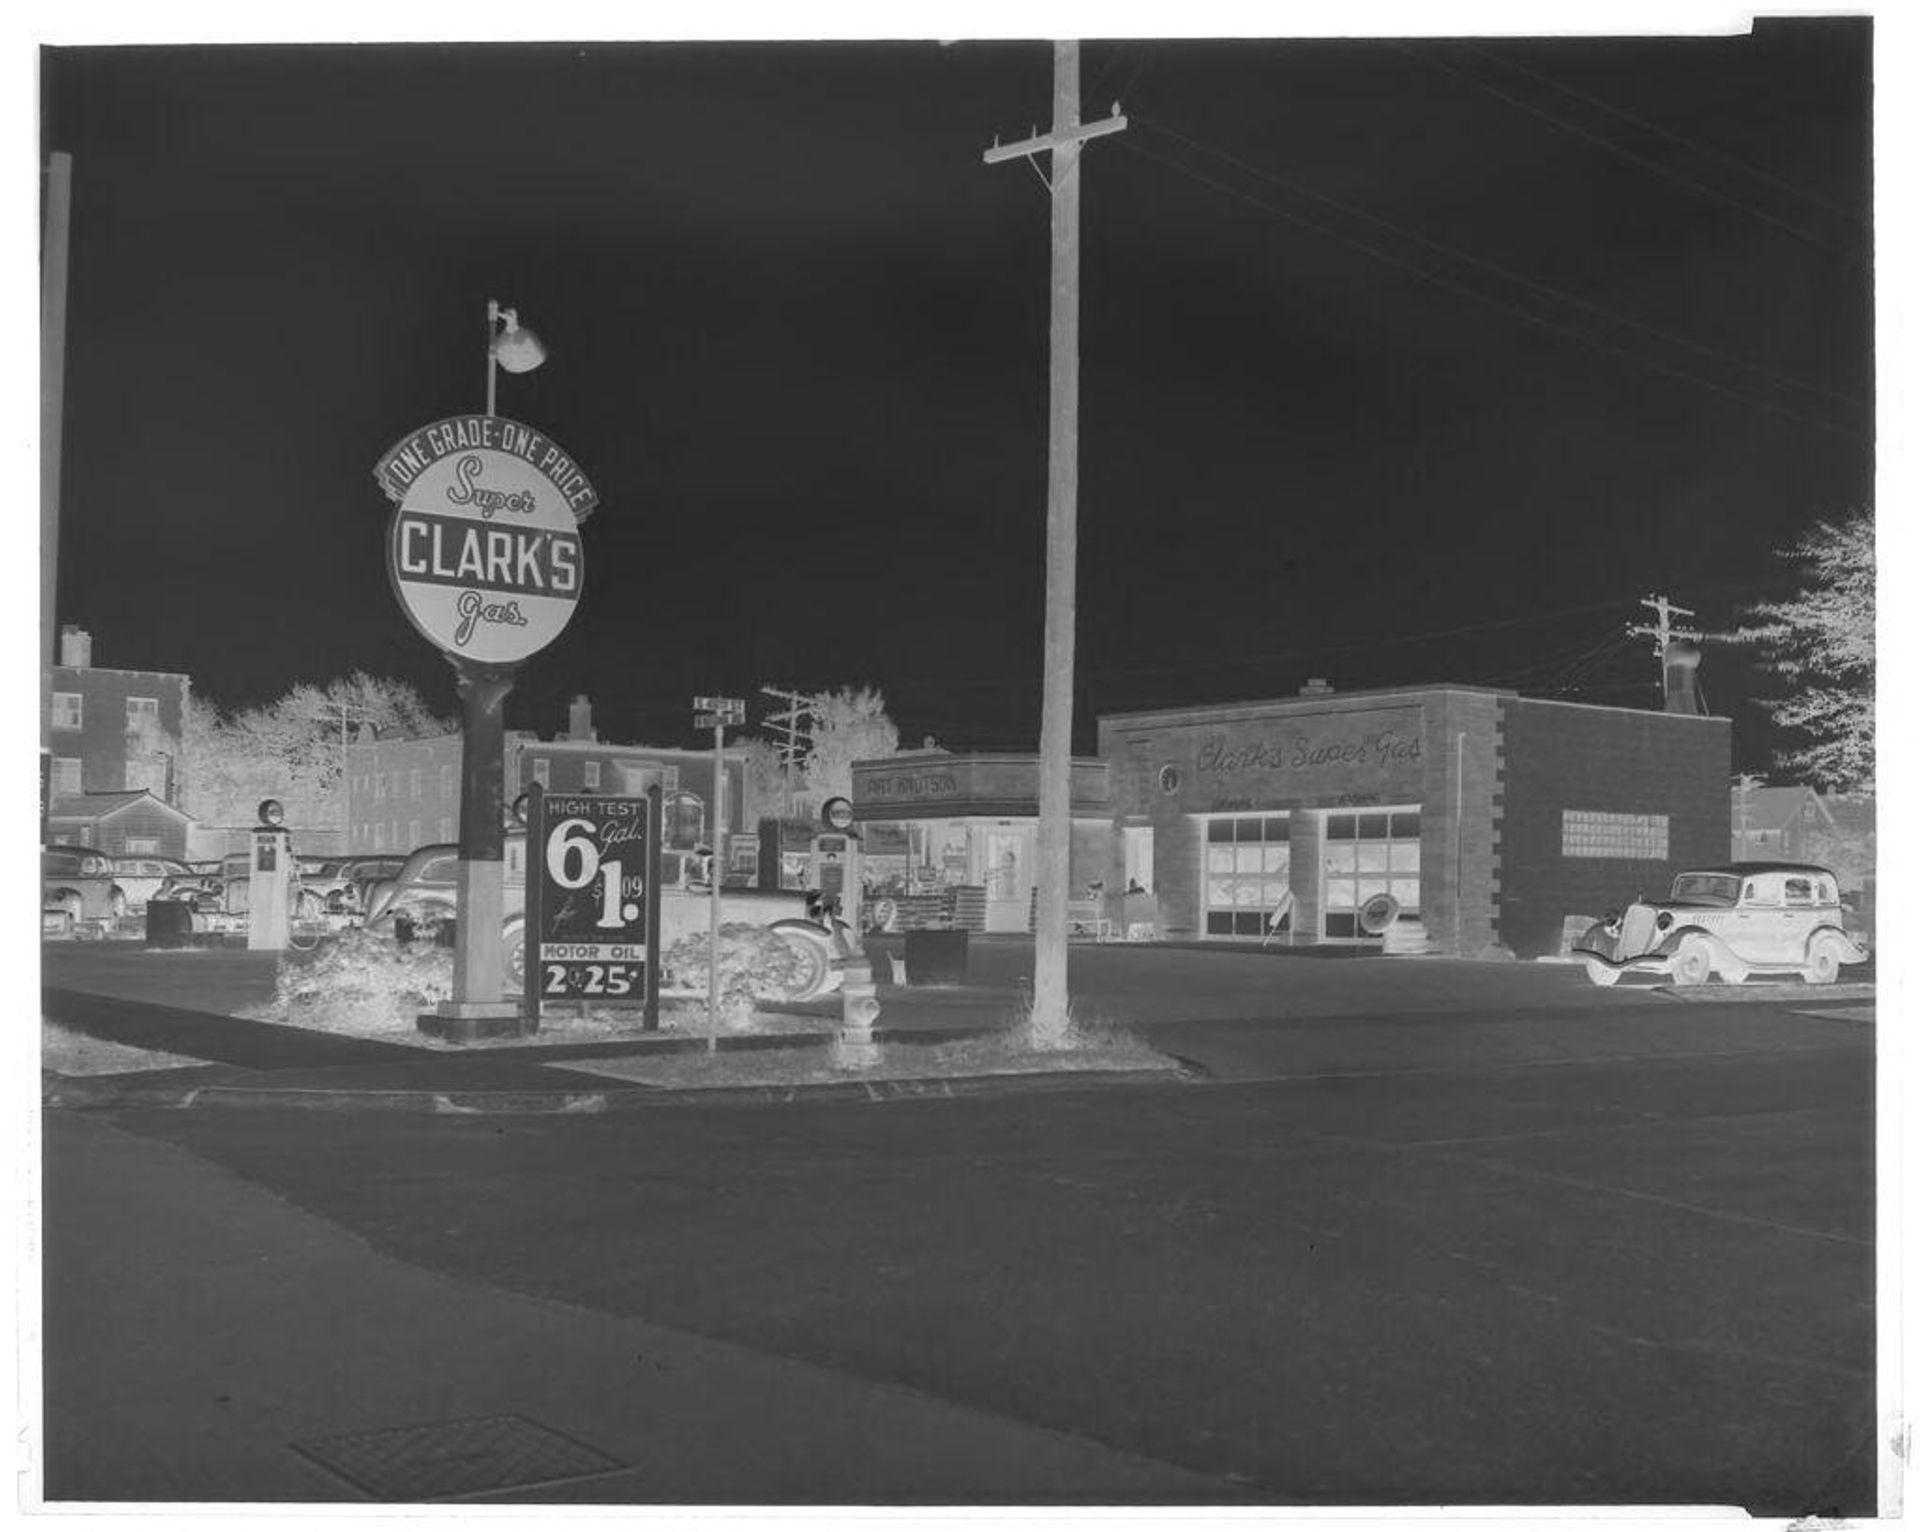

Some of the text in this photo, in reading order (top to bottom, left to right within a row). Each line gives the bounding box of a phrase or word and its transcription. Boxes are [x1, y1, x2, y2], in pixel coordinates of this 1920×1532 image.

[390, 439, 426, 484] ONE
[539, 447, 594, 511] PRICE
[447, 455, 536, 518] Super
[401, 520, 576, 591] CLARK'S
[1291, 736, 1367, 767] Super
[549, 802, 641, 815] HIGH TEST
[547, 819, 600, 889] 6
[543, 945, 640, 960] MOTOR OIL
[546, 965, 567, 994] 2
